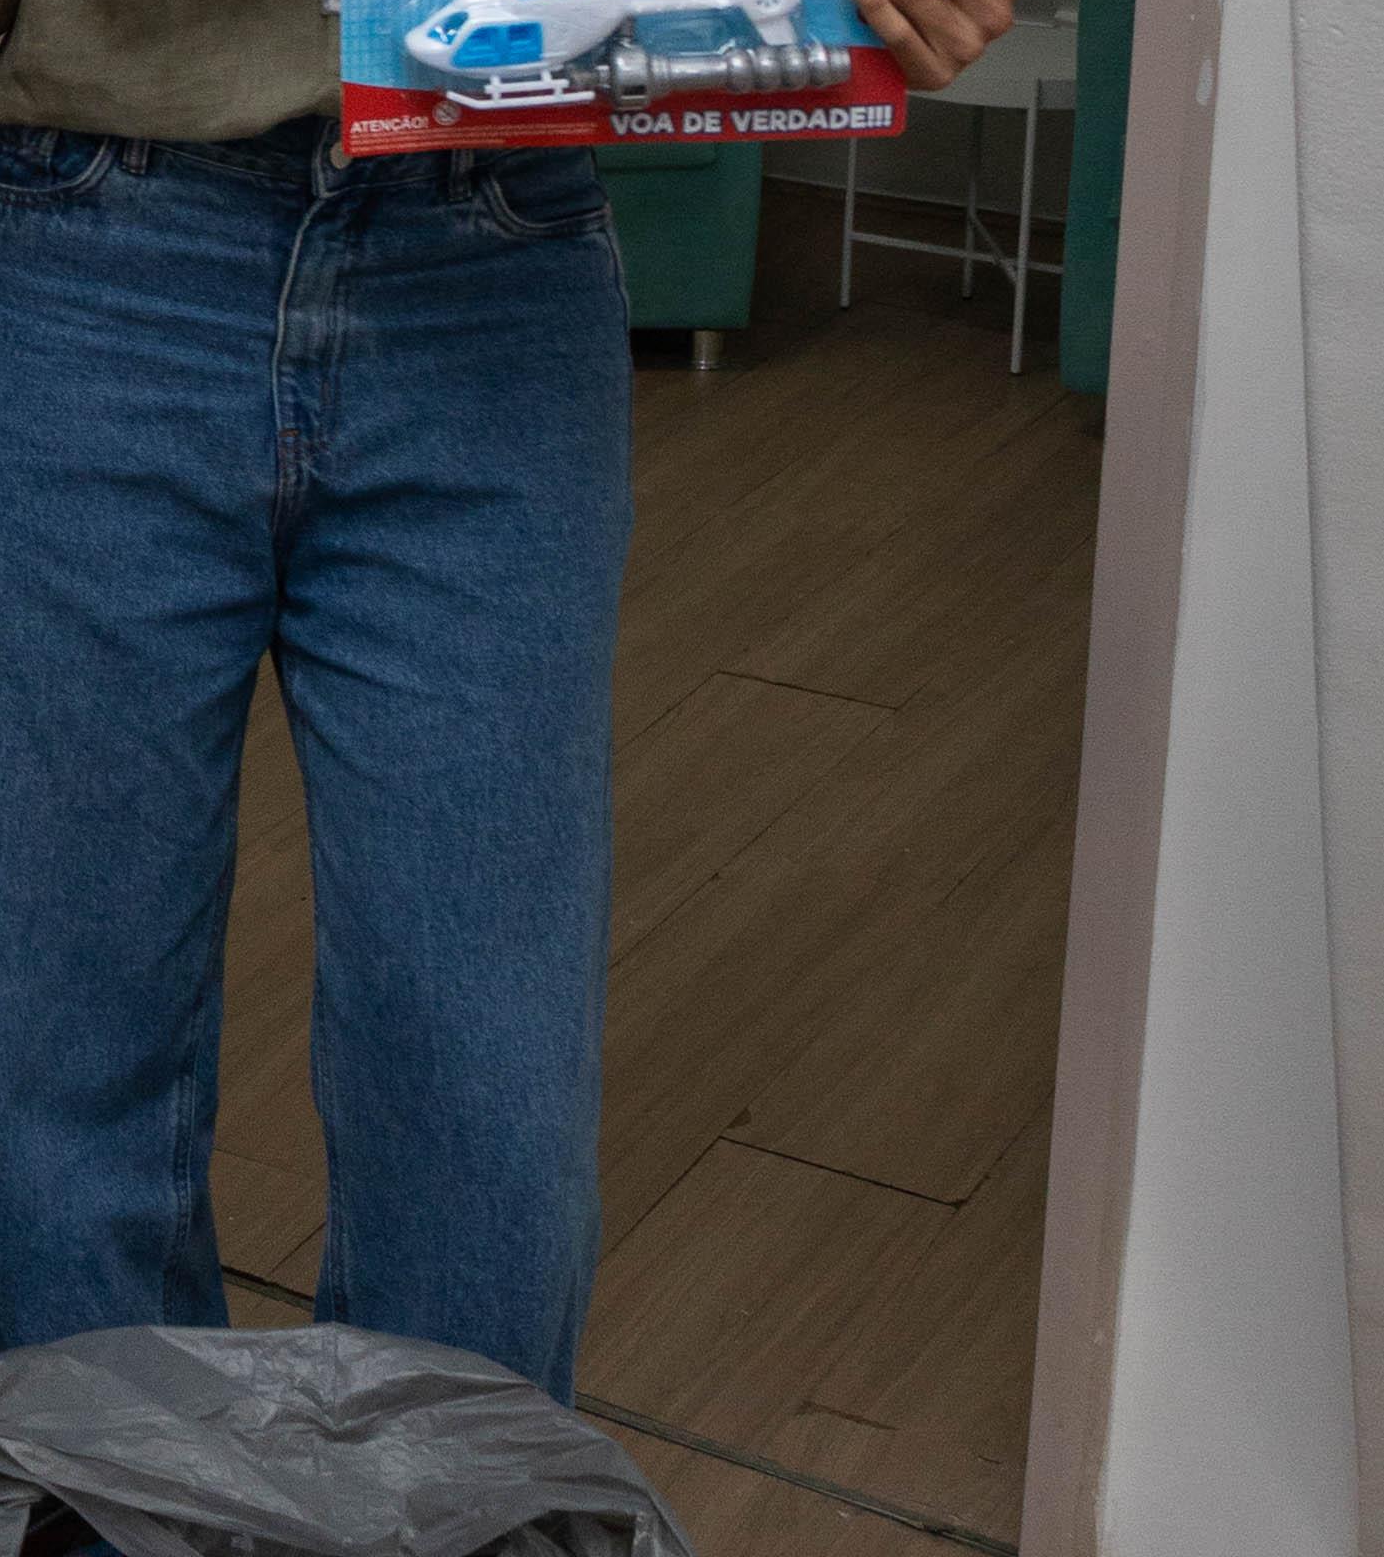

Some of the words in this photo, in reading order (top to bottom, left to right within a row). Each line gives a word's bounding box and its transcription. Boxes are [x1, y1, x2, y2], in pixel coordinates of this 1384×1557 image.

[349, 115, 430, 134] ATENÇÃO!
[609, 110, 675, 136] VOA
[682, 110, 723, 134] DE
[730, 104, 894, 134] VERDADE!!!
